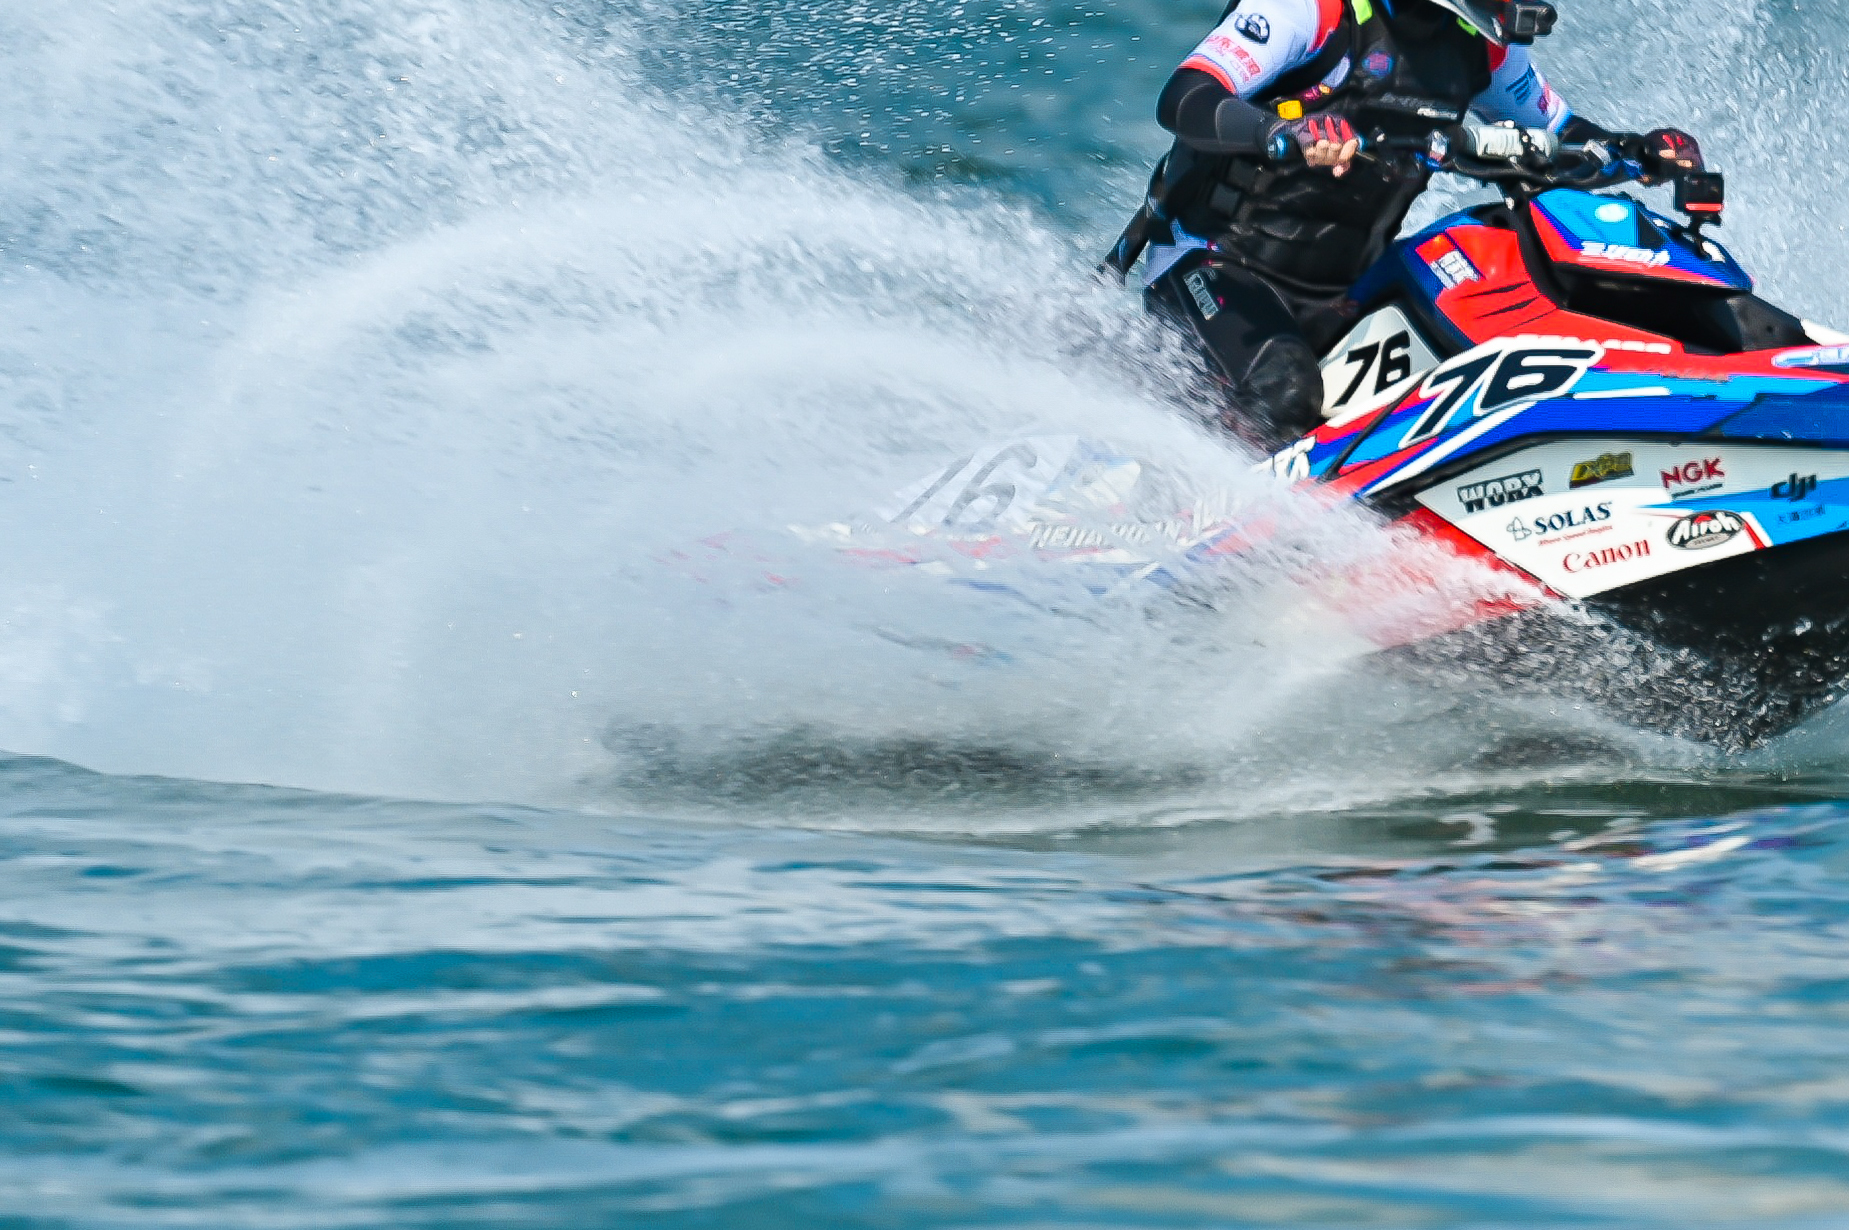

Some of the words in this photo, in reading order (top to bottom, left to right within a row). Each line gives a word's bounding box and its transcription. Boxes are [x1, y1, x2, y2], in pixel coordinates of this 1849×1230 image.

[1333, 331, 1411, 408] 76
[1412, 349, 1596, 440] 76
[1660, 457, 1725, 489] NGK
[1534, 502, 1611, 535] SOLAS
[1563, 539, 1650, 573] Canon
